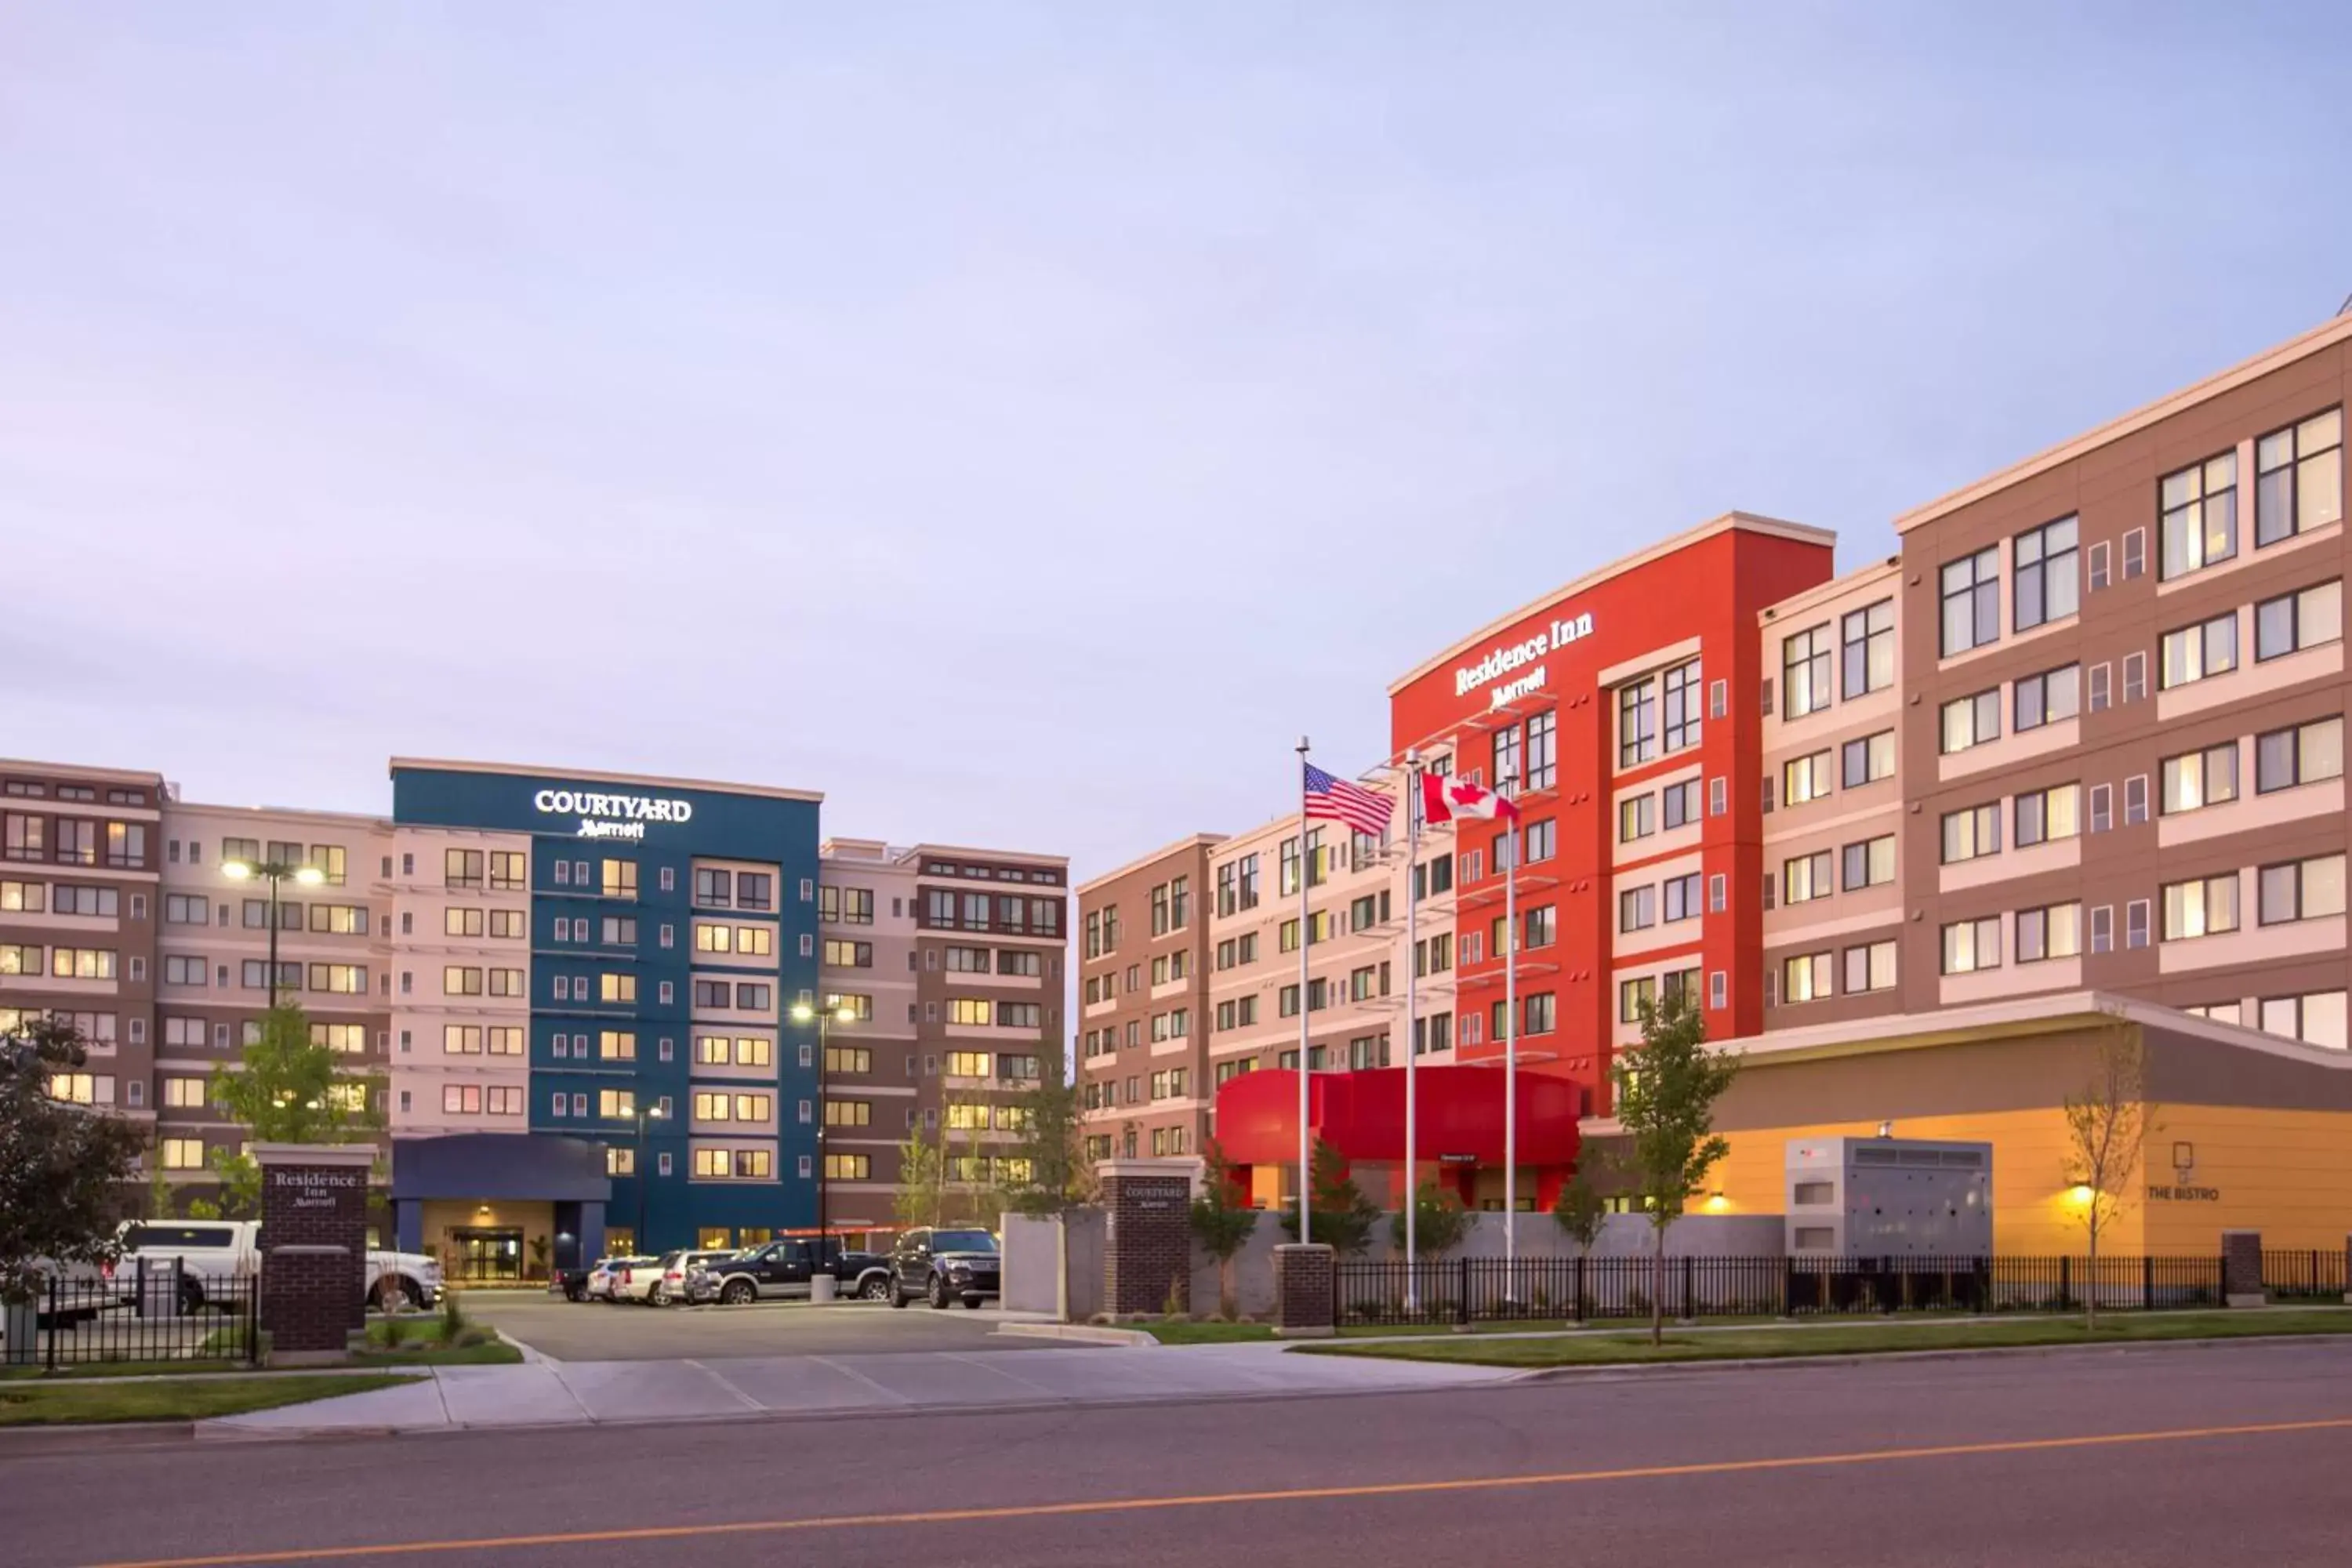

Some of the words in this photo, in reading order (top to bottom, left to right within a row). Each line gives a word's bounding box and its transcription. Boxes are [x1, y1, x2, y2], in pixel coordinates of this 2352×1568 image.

[1456, 633, 1548, 696] Residence
[1550, 612, 1593, 649] Inn
[1490, 666, 1545, 708] Marriott
[535, 789, 692, 822] COURTYARD
[577, 818, 644, 838] Marriott
[275, 1172, 356, 1187] Residence
[304, 1188, 327, 1197] Inn
[2148, 1186, 2171, 1200] THE
[2174, 1187, 2220, 1202] BISTRO
[292, 1197, 336, 1207] Marriott
